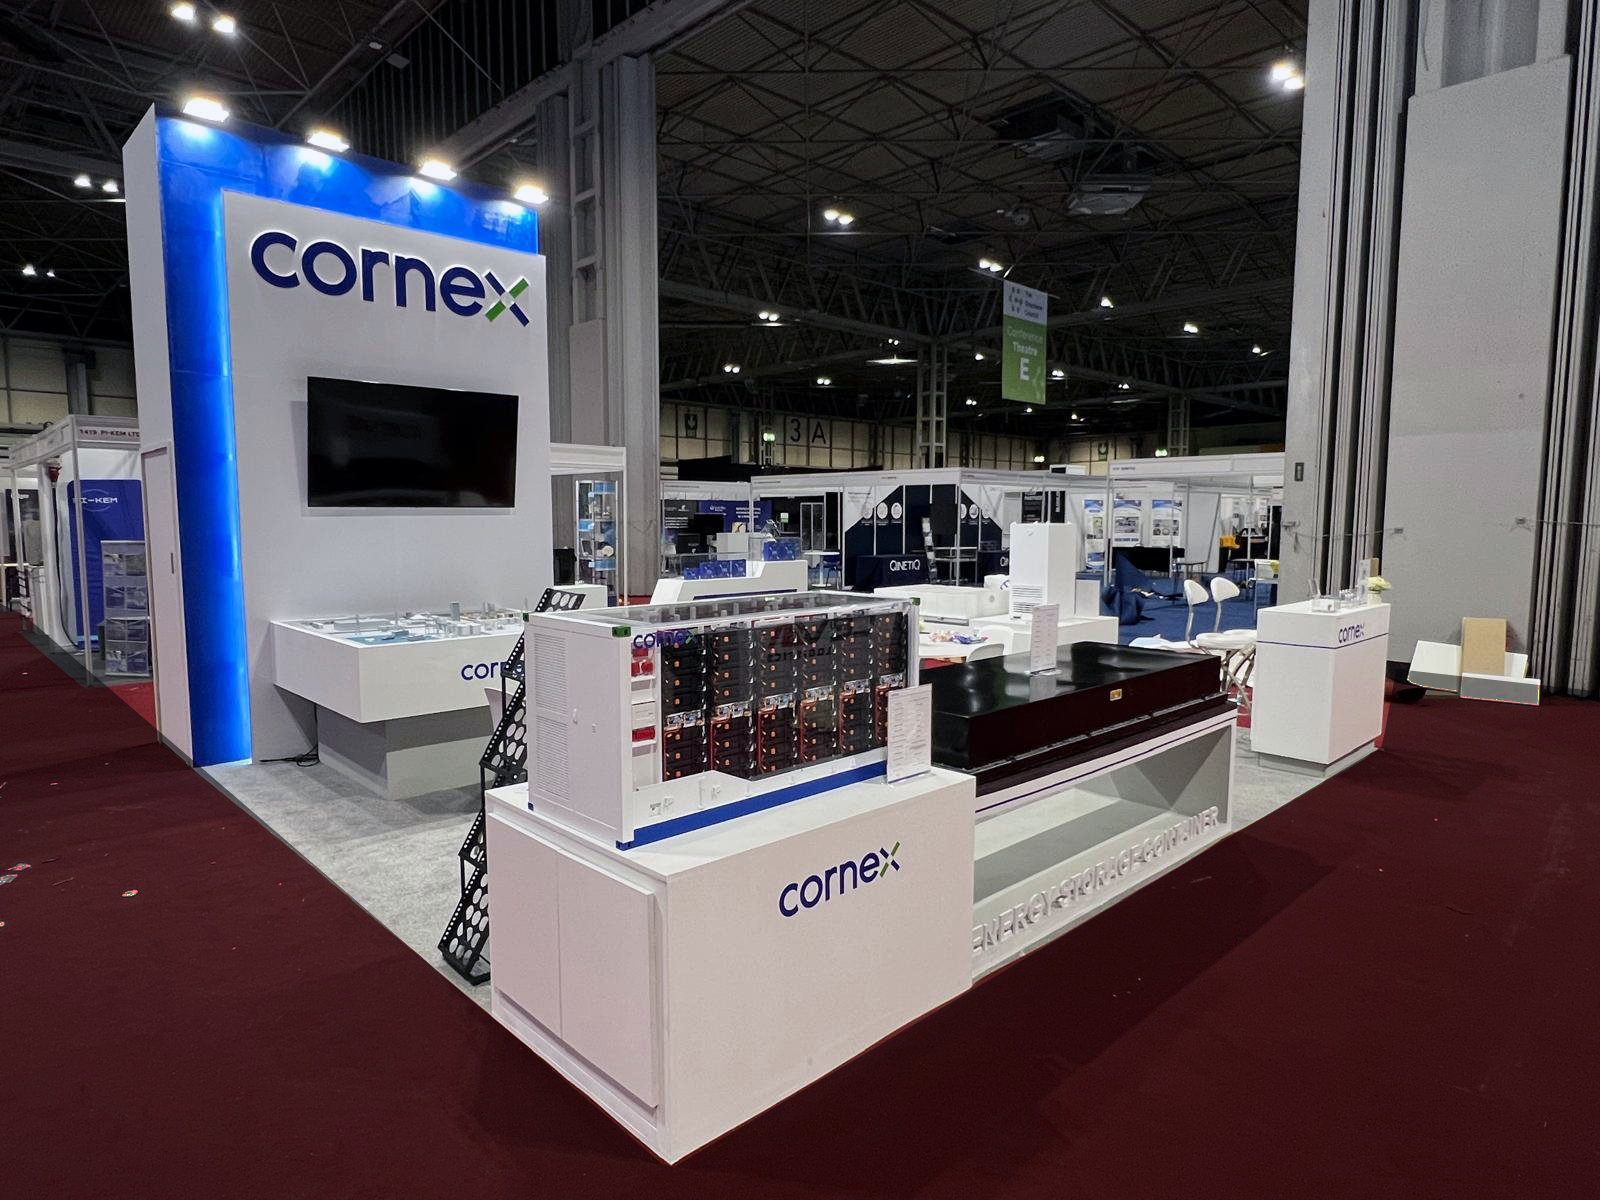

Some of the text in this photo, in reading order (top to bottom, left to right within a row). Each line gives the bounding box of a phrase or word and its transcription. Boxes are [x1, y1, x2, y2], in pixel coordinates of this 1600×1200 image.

[250, 231, 530, 327] cornex
[1020, 358, 1030, 381] E
[100, 429, 126, 437] PI-KEM
[790, 418, 826, 445] 3 A
[633, 629, 697, 649] cornex
[1339, 623, 1365, 644] cornex
[779, 841, 900, 917] cornex
[972, 806, 1219, 953] ENERGY STORAGE CONTAINER
